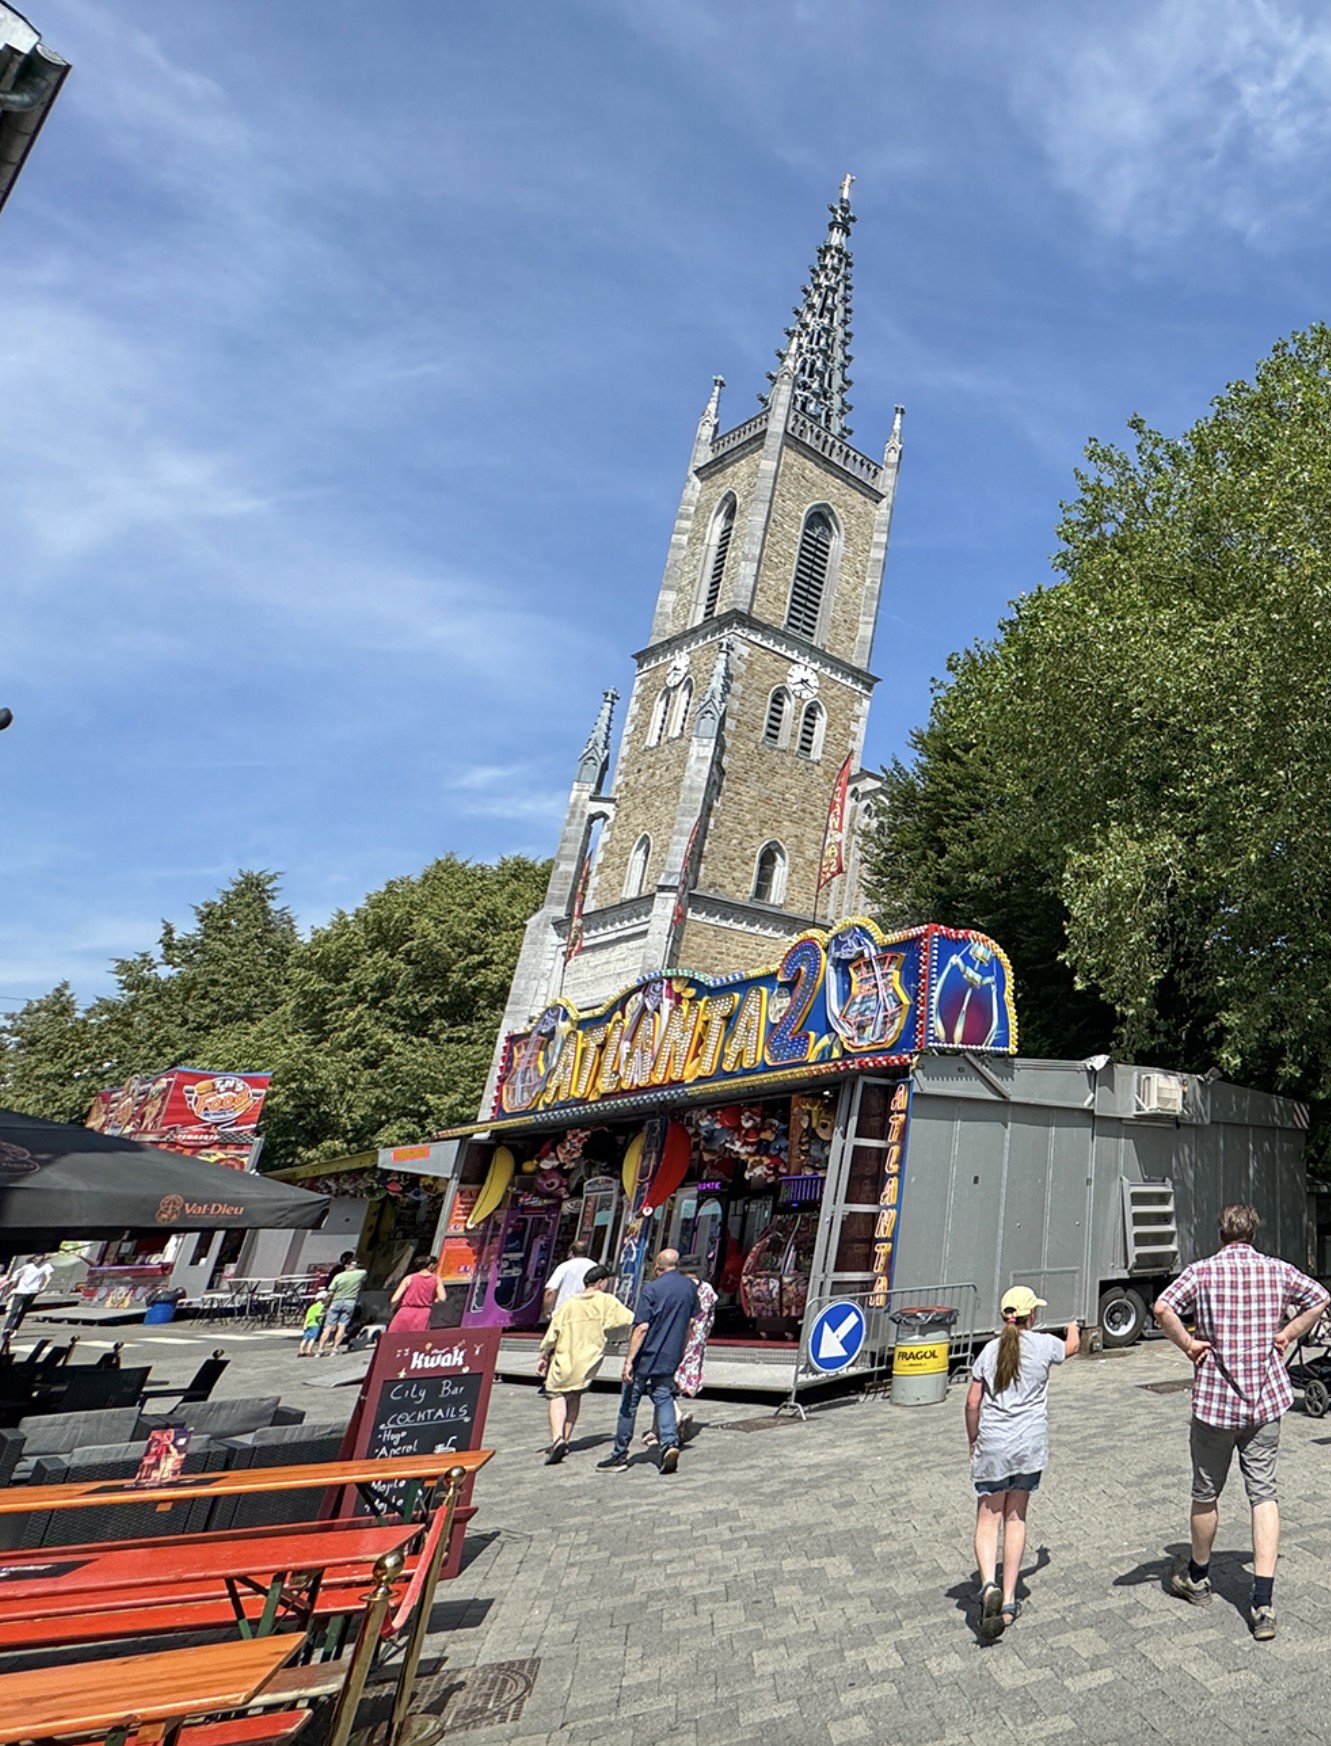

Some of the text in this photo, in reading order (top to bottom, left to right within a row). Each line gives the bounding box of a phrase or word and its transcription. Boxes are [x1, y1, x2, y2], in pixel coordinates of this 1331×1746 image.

[544, 937, 827, 1103] ATLANTA 2
[869, 1082, 908, 1307] ATLANTA
[438, 1380, 465, 1398] Bar
[897, 1350, 939, 1361] FRAGOL
